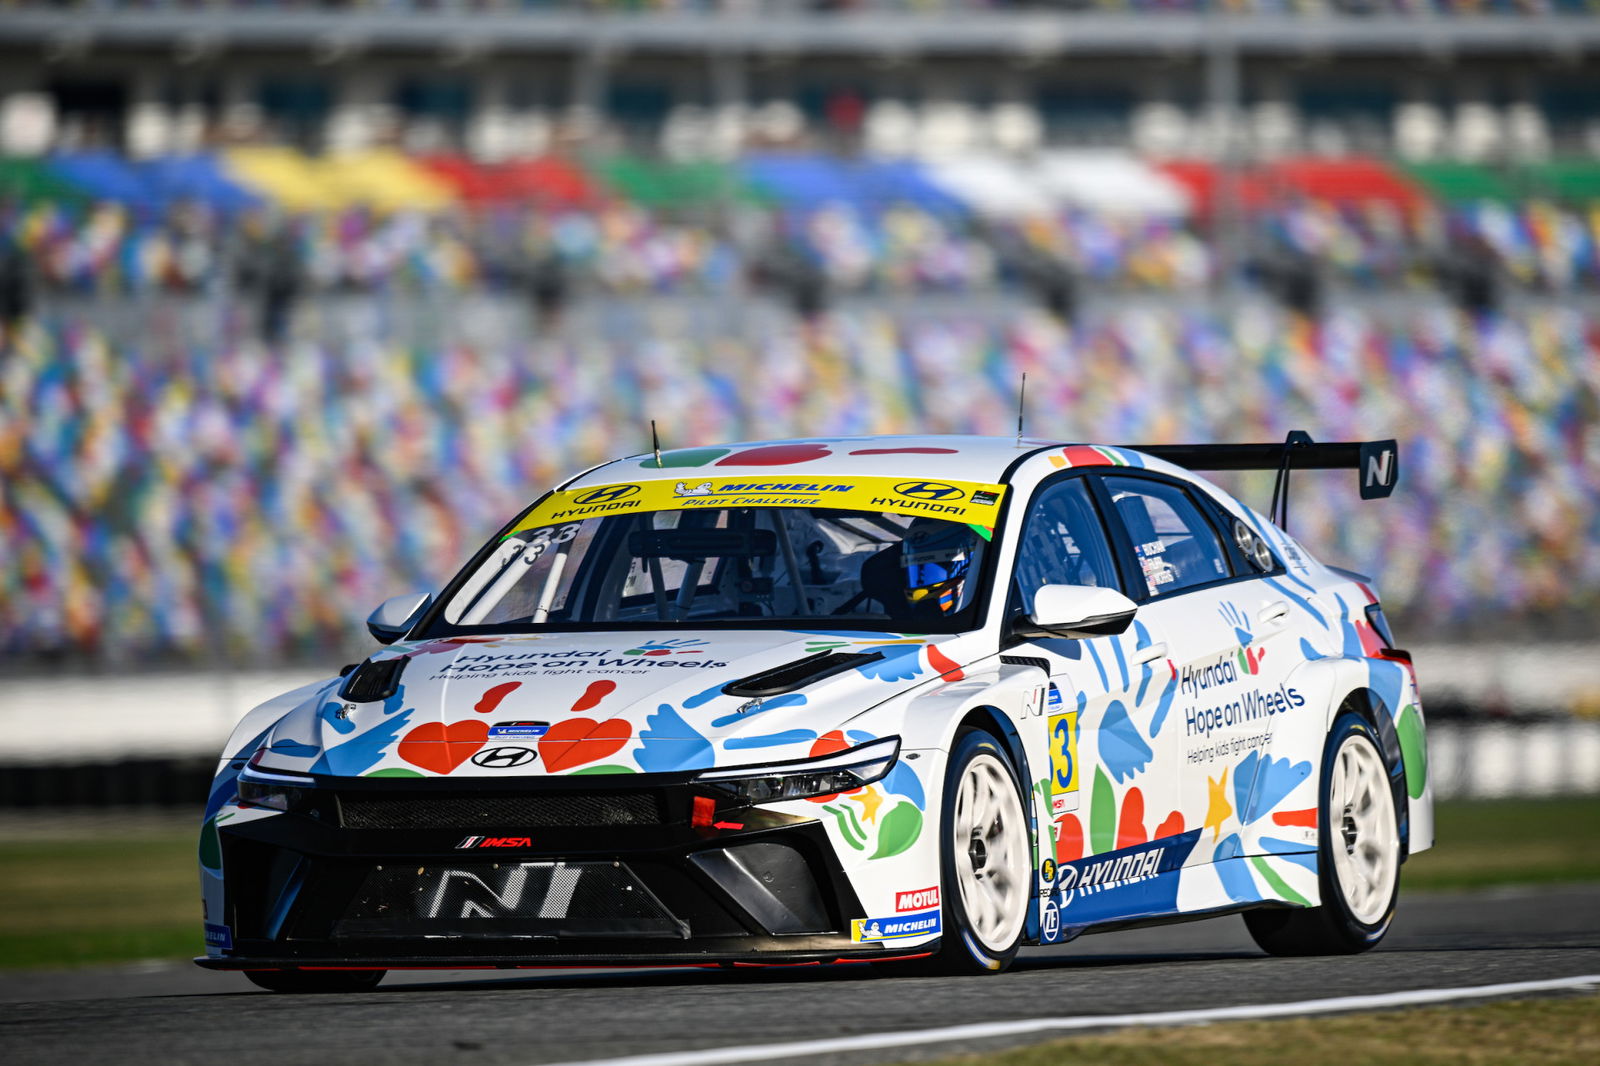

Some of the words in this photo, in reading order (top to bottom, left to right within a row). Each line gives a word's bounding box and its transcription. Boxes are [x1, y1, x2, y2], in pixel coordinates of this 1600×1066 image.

[718, 483, 855, 493] MICHELIN
[551, 500, 641, 520] HYUNDAI
[682, 498, 729, 507] PILOT
[731, 497, 821, 506] CHALLENGE
[871, 497, 967, 516] HYUNDAI
[440, 662, 537, 673] Hope
[542, 659, 589, 668] on
[598, 658, 726, 669] Wheels
[455, 649, 612, 663] Hyundai
[429, 672, 497, 680] Helping
[542, 668, 580, 676] fight
[1181, 651, 1237, 699] Hyundai
[1185, 706, 1223, 738] Hope
[1224, 701, 1242, 727] on
[1241, 683, 1305, 722] Wheels
[1049, 718, 1074, 789] 3
[1214, 739, 1230, 757] kids
[1247, 733, 1273, 750] cancer
[480, 837, 532, 848] IMSA
[1078, 847, 1165, 897] HYUNDAI
[898, 889, 939, 910] MOTUL
[884, 918, 937, 934] MICHELIN
